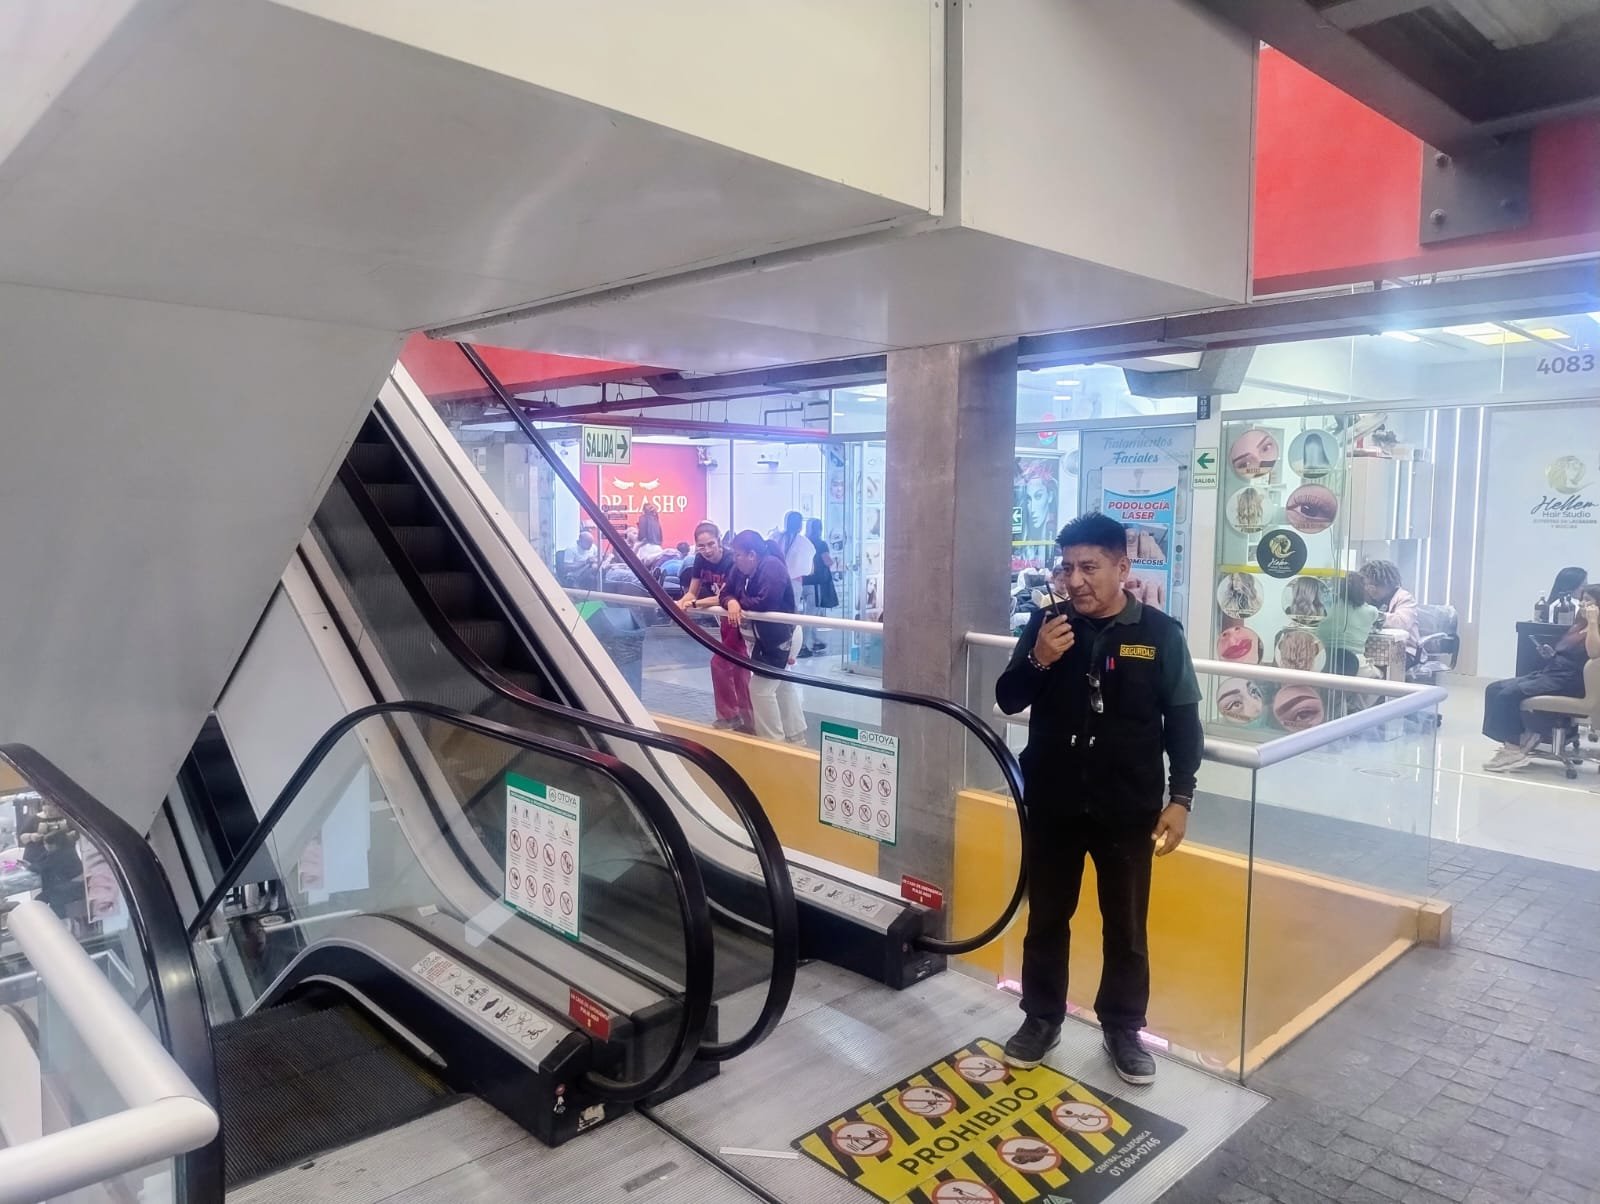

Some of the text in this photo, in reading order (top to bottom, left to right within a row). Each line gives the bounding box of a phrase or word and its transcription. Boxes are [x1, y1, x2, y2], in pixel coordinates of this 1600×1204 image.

[1536, 354, 1595, 375] 4083
[586, 432, 614, 459] SALIDA
[1112, 451, 1159, 465] Faciales
[628, 495, 675, 512] LASH
[1122, 511, 1155, 520] LASER
[868, 733, 895, 745] OTOYA
[897, 1086, 1038, 1176] PROHIBIDO
[1094, 1153, 1122, 1174] CENTRAL
[1109, 1137, 1161, 1177] 01 684-0746
